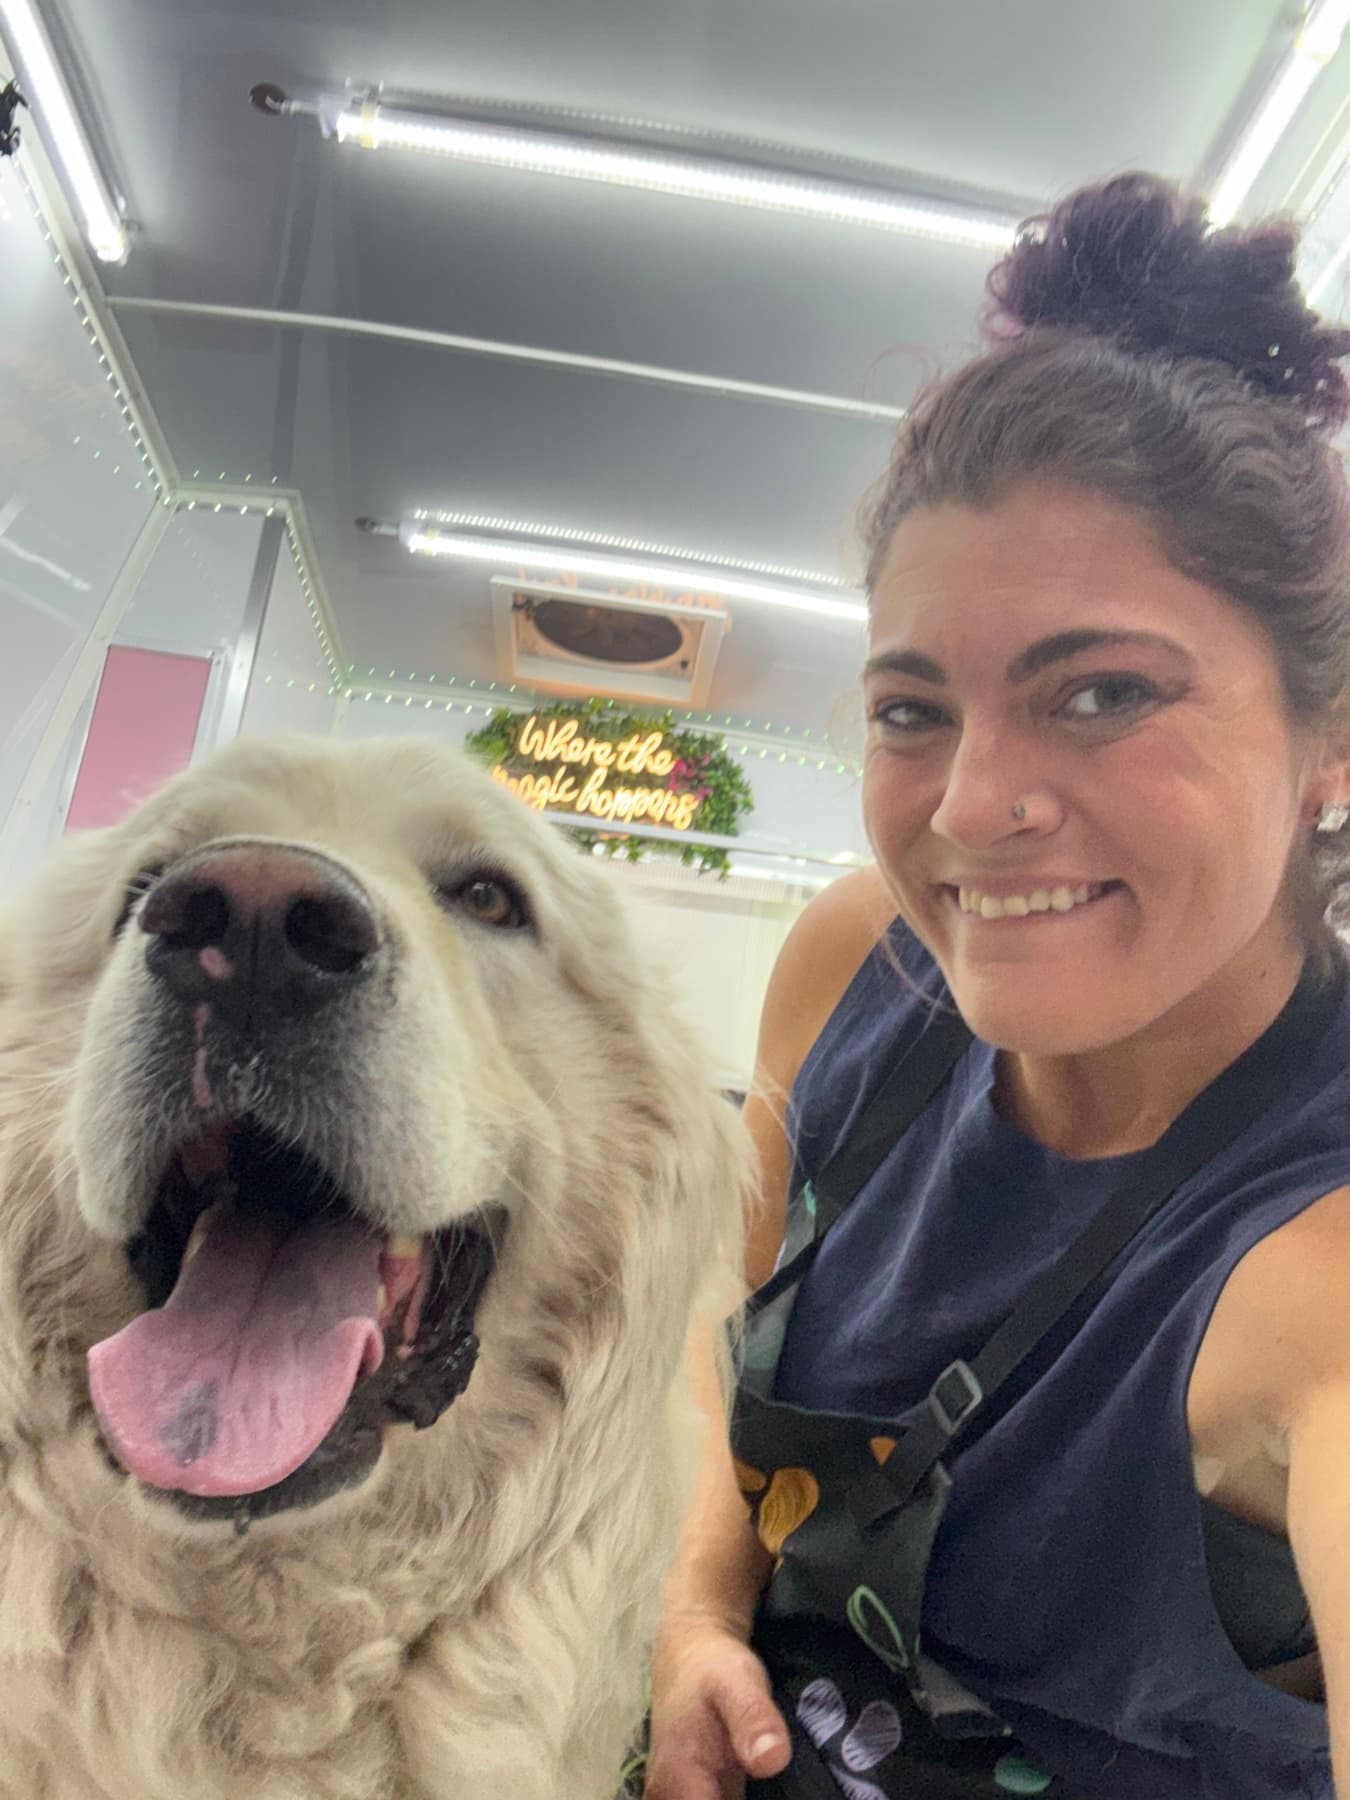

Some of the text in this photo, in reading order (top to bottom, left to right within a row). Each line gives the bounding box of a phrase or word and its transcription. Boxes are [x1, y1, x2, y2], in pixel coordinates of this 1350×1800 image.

[518, 715, 677, 776] Where the
[576, 766, 699, 831] happens
